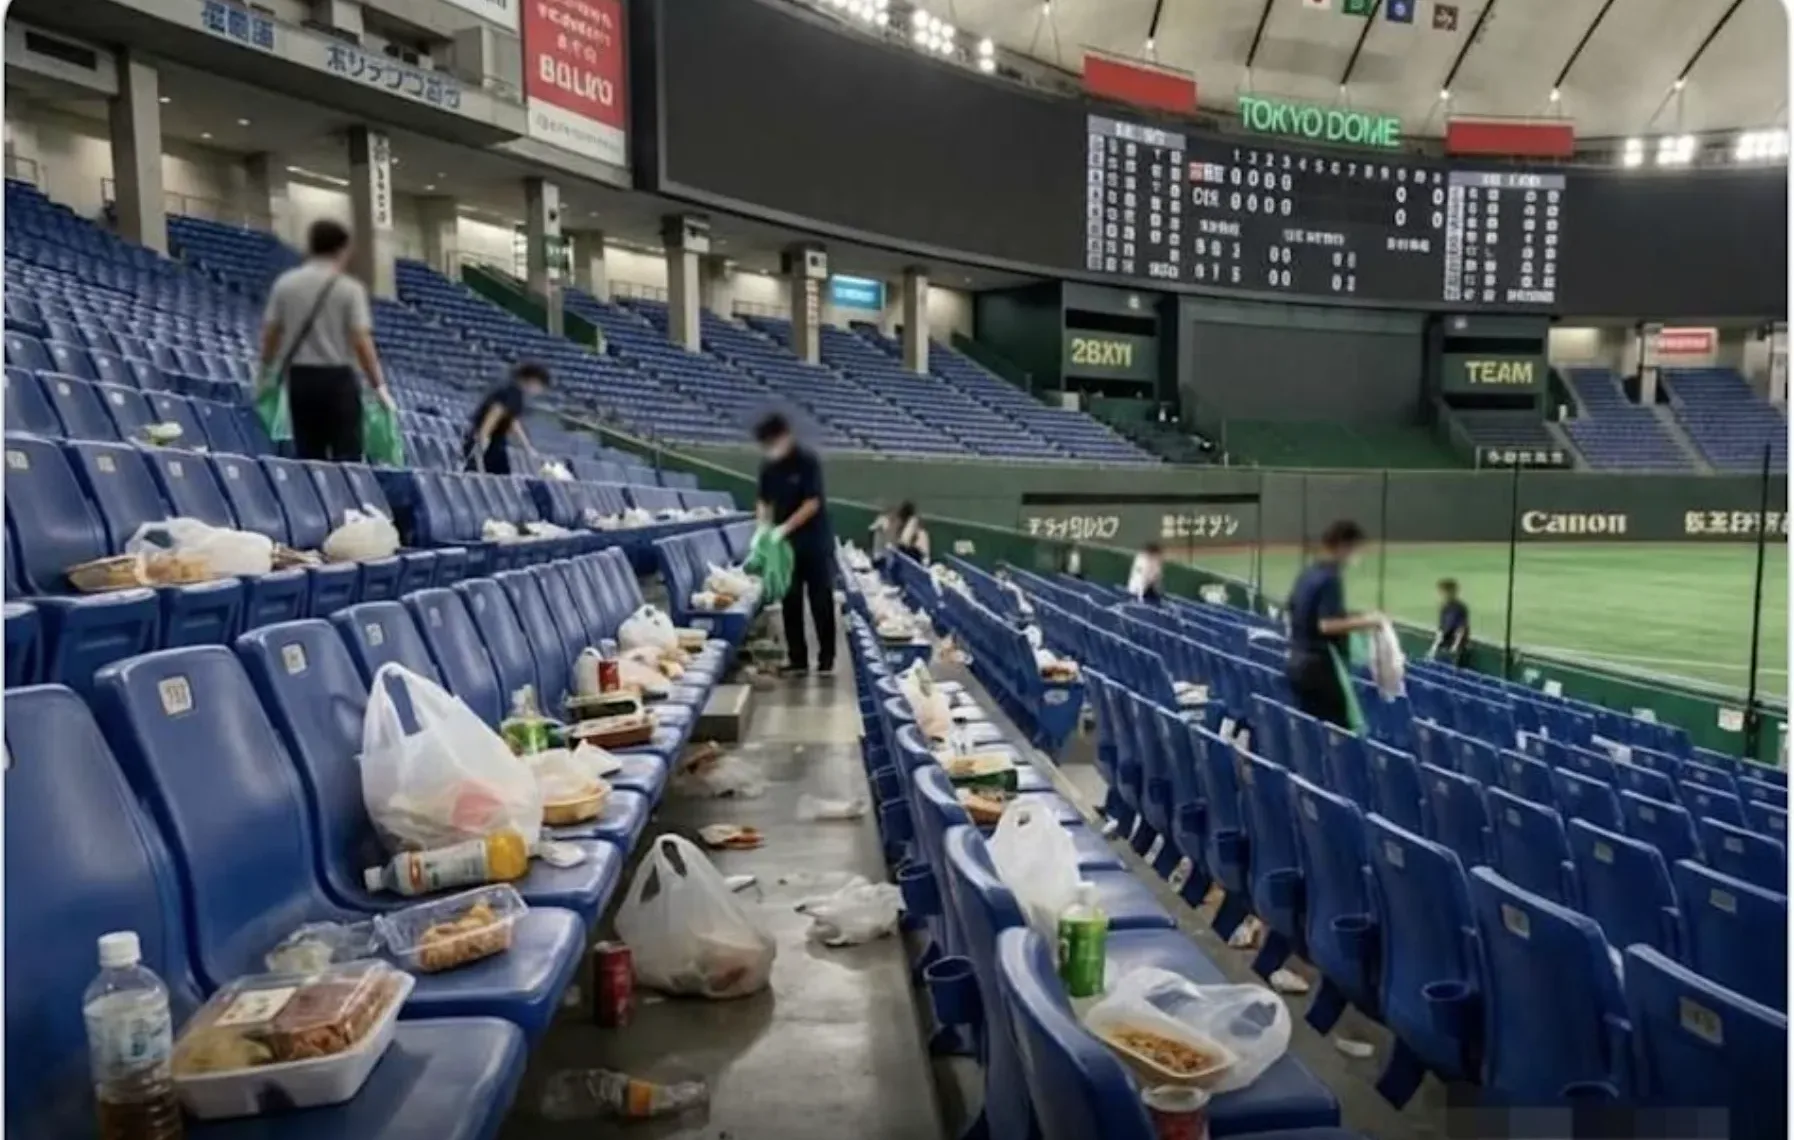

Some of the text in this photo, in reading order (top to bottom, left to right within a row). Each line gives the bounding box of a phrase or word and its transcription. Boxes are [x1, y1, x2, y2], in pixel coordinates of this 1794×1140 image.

[1239, 97, 1400, 147] TOKYO DOME
[1464, 361, 1533, 384] TEAM
[1521, 510, 1627, 534] Canon
